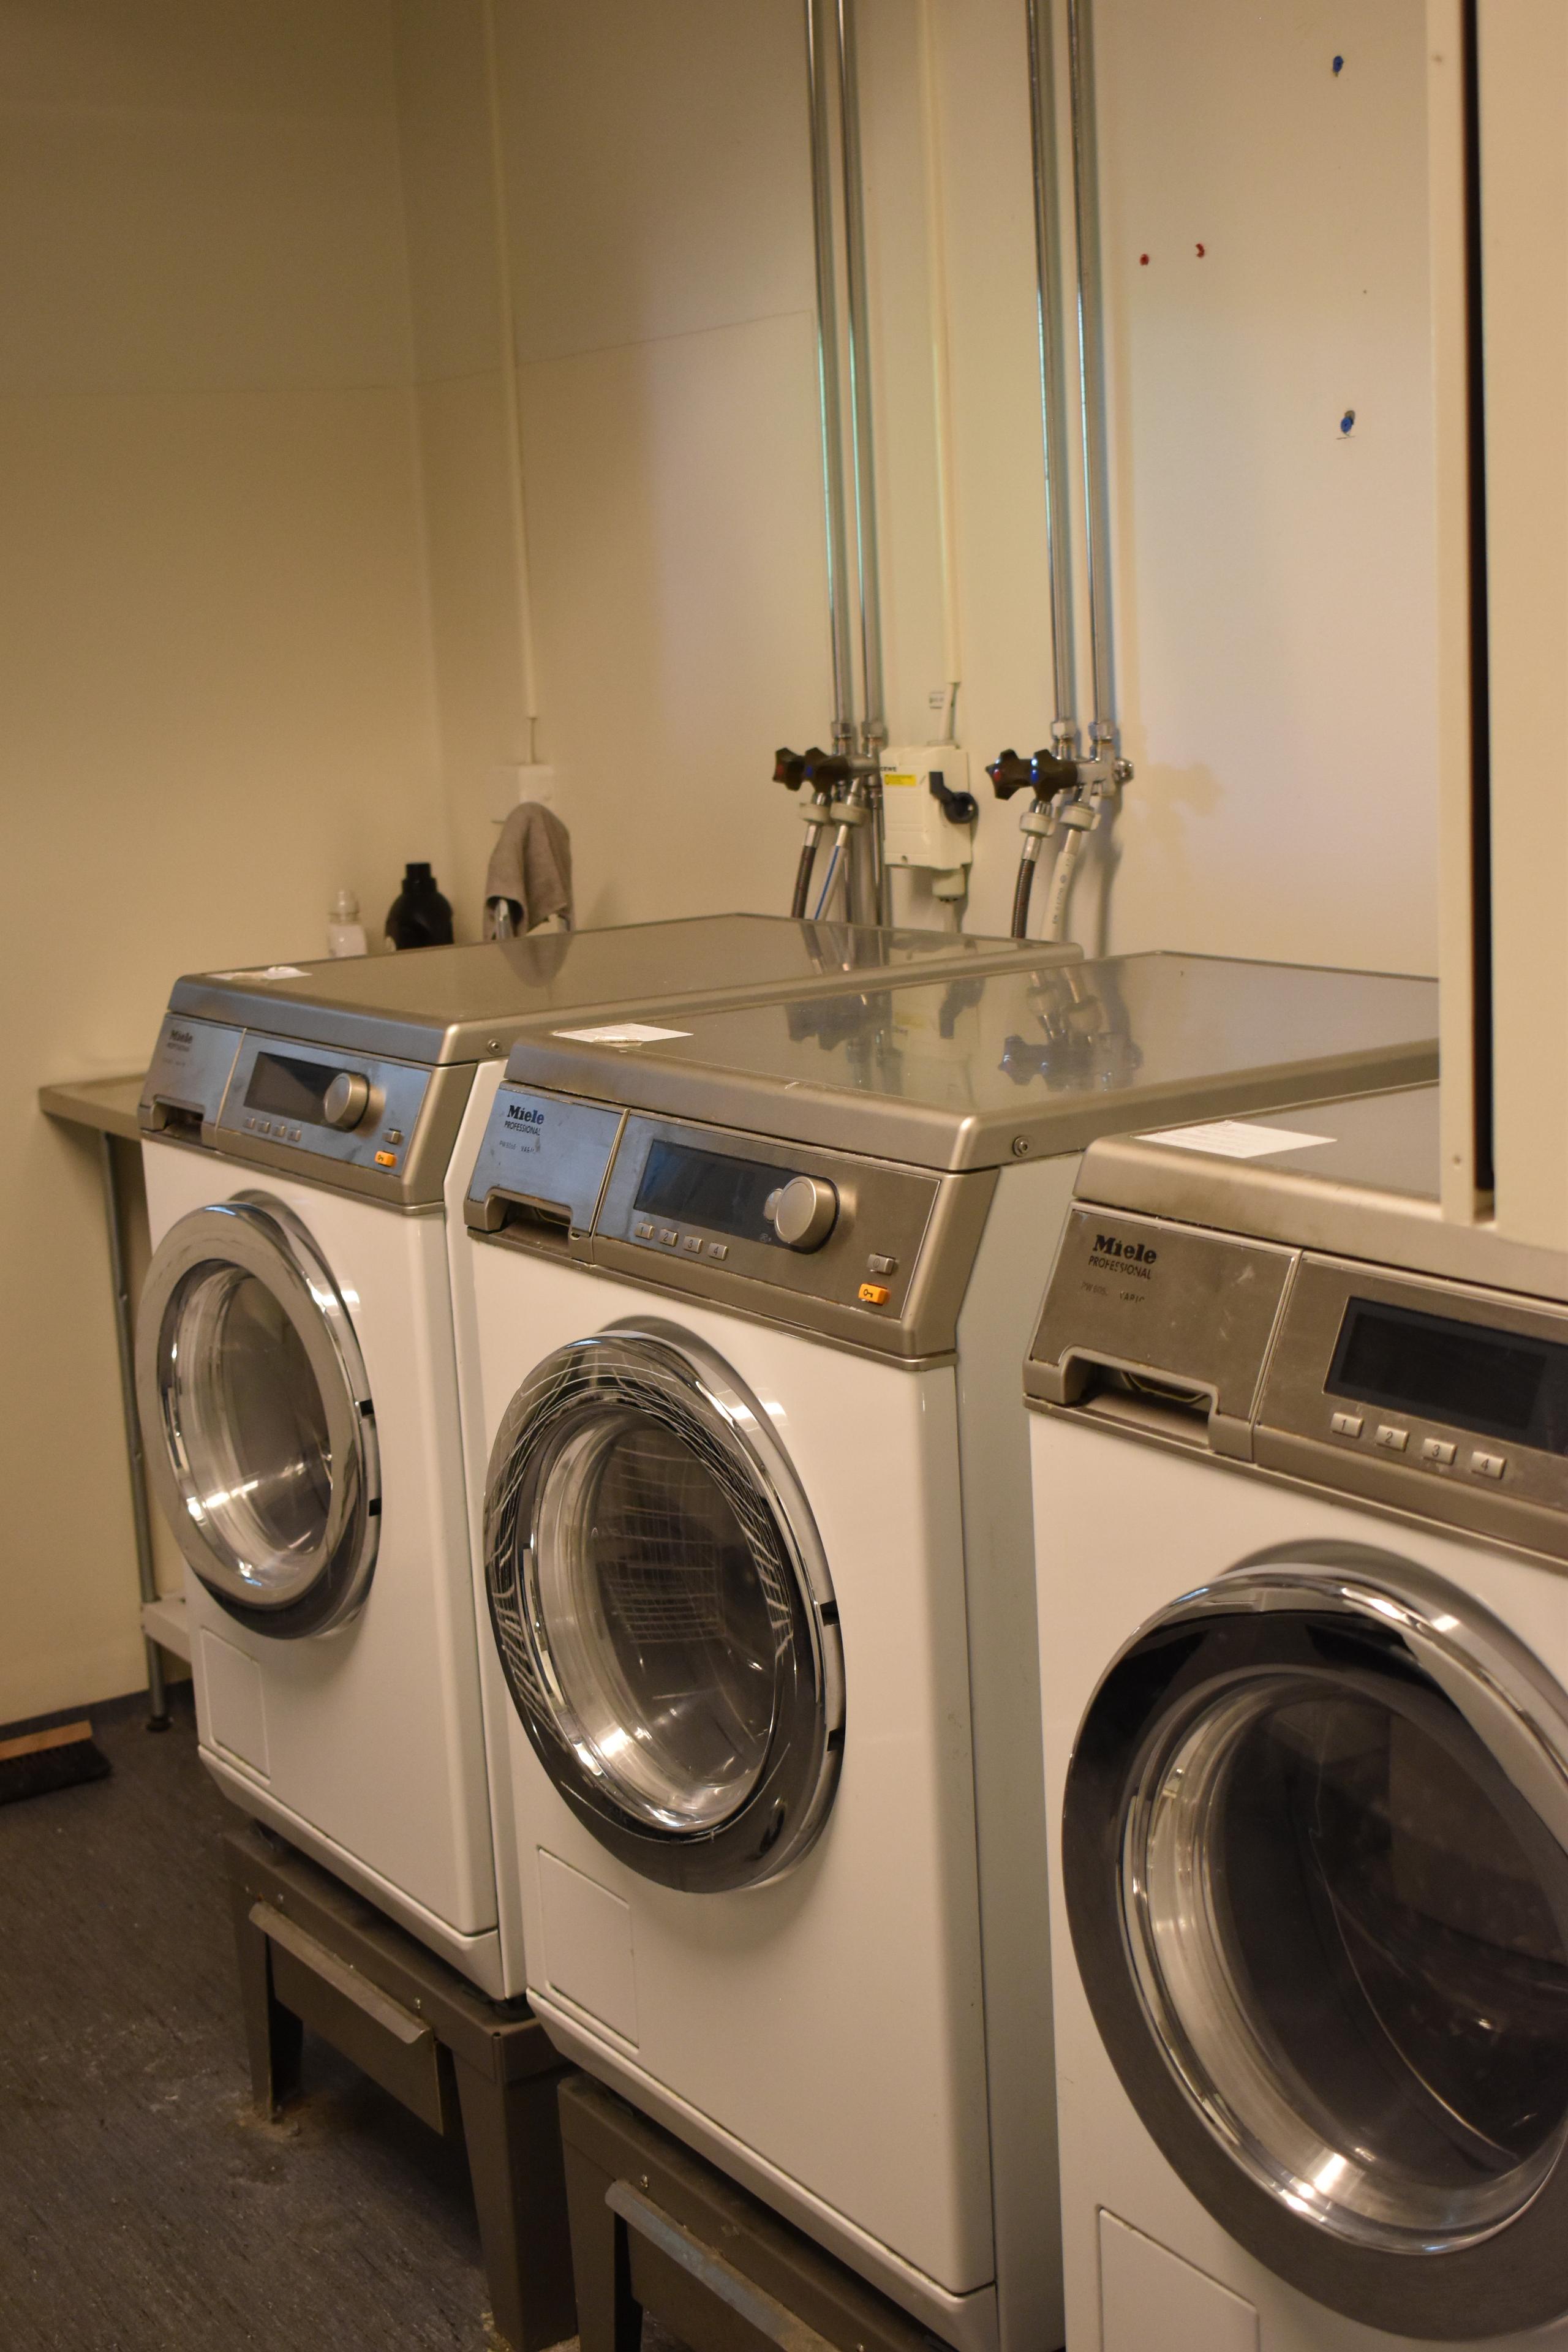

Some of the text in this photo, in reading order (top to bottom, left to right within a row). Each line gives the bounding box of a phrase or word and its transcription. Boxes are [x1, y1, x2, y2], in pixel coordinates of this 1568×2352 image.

[507, 1105, 545, 1125] Miele
[504, 1121, 541, 1136] PROFESSIONAL
[639, 1227, 644, 1235] 1
[663, 1232, 668, 1242] 2
[688, 1239, 693, 1249] 3
[1093, 1234, 1156, 1264] Miele
[714, 1246, 719, 1256] 4
[1088, 1256, 1152, 1280] PROFESSIONAL
[1341, 1419, 1346, 1431] 1
[1385, 1431, 1393, 1444] 2
[1432, 1445, 1440, 1457] 3
[1481, 1459, 1489, 1471] 4
